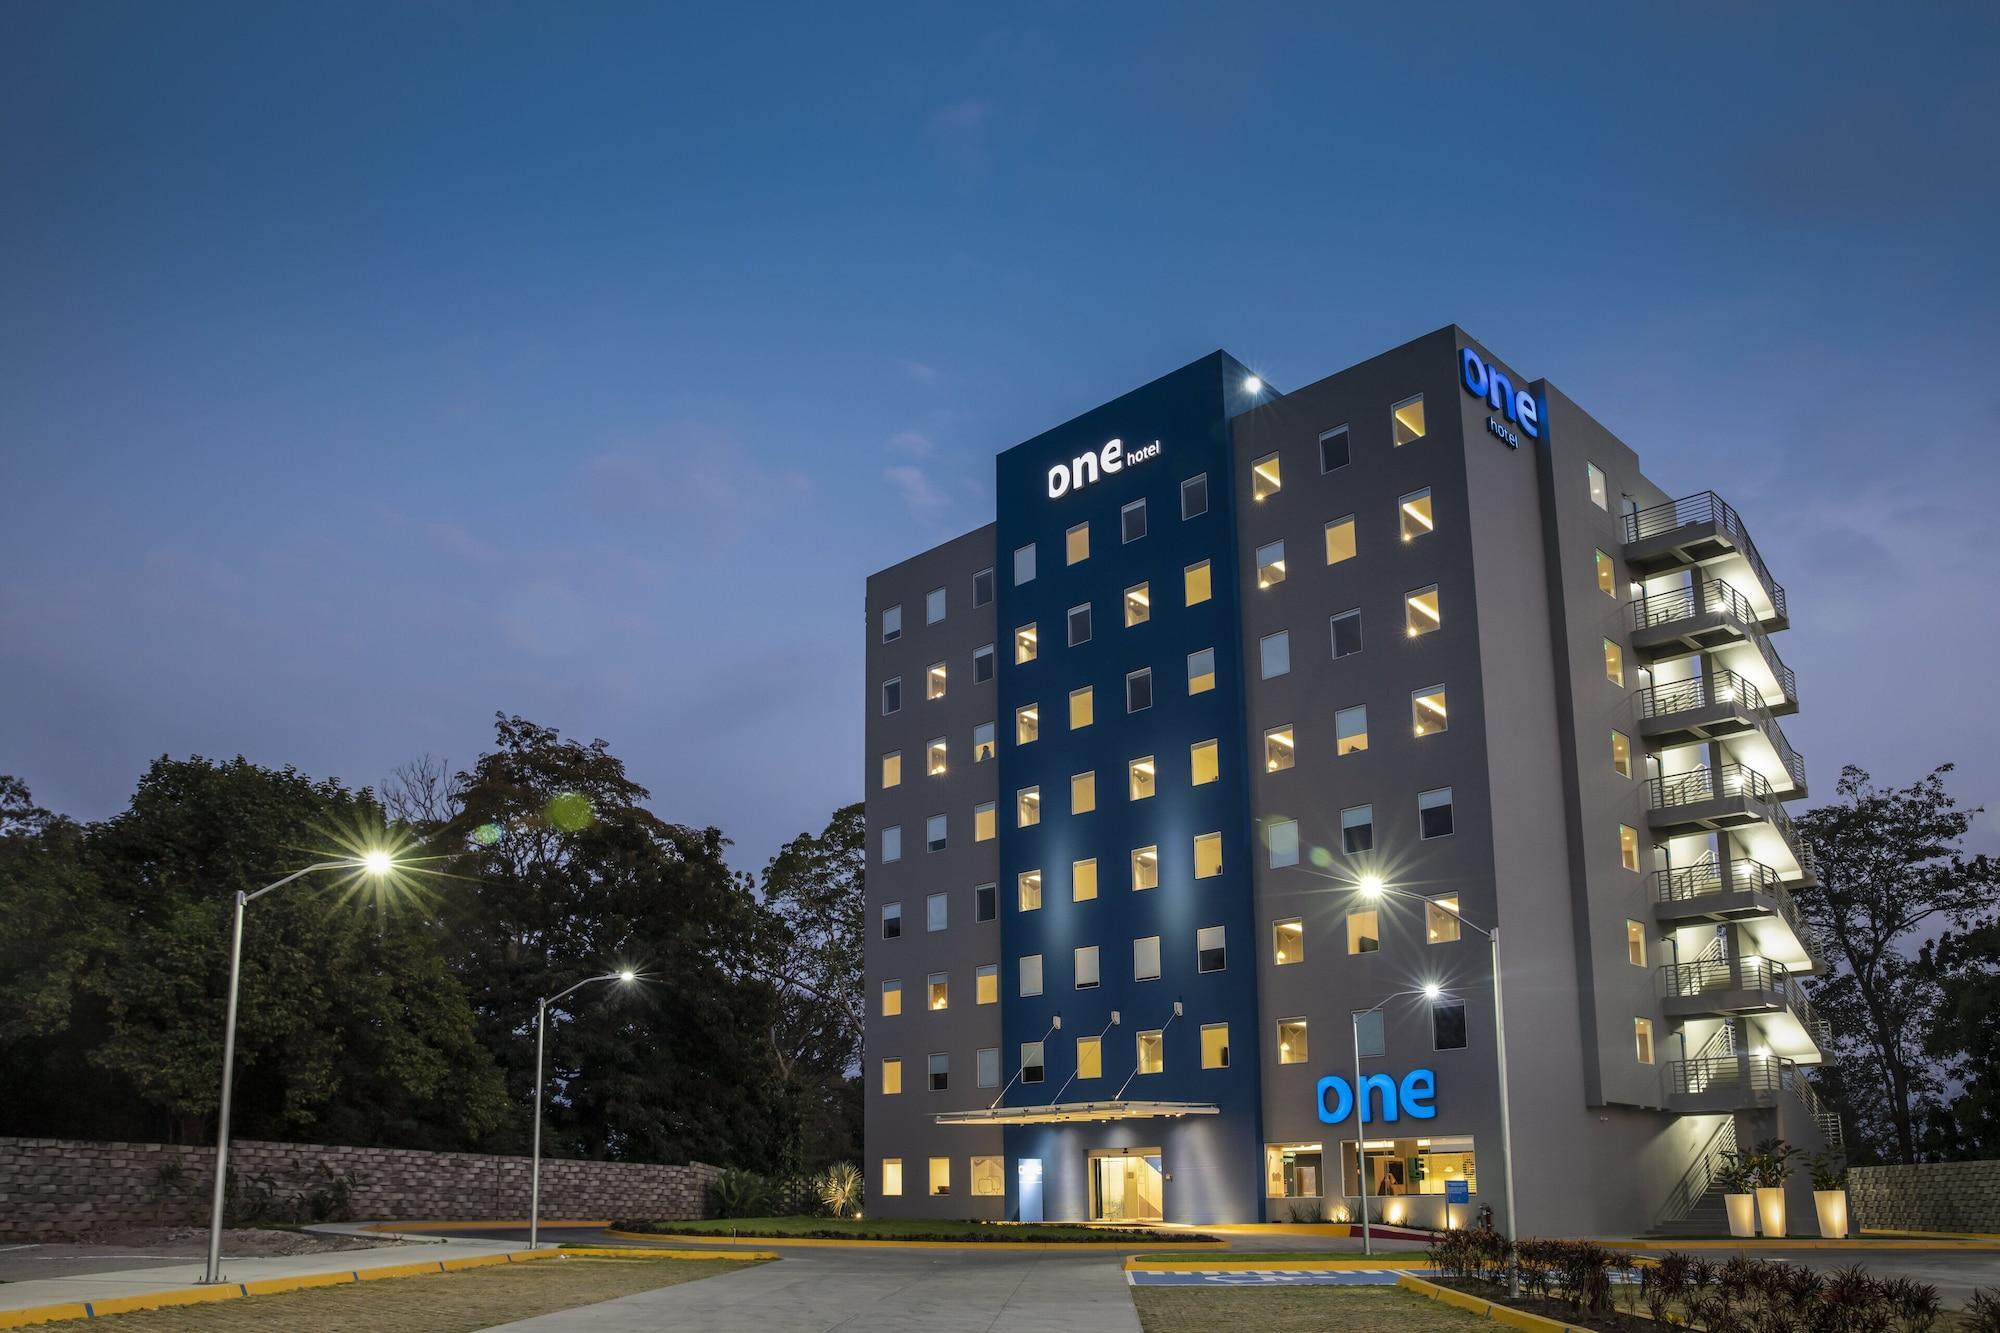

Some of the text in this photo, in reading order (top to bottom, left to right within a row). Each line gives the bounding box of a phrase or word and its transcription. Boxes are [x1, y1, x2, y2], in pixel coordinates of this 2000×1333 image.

[1461, 347, 1538, 439] one
[1489, 416, 1519, 449] hotel
[1048, 438, 1160, 499] one hotel
[1316, 1068, 1437, 1124] one
